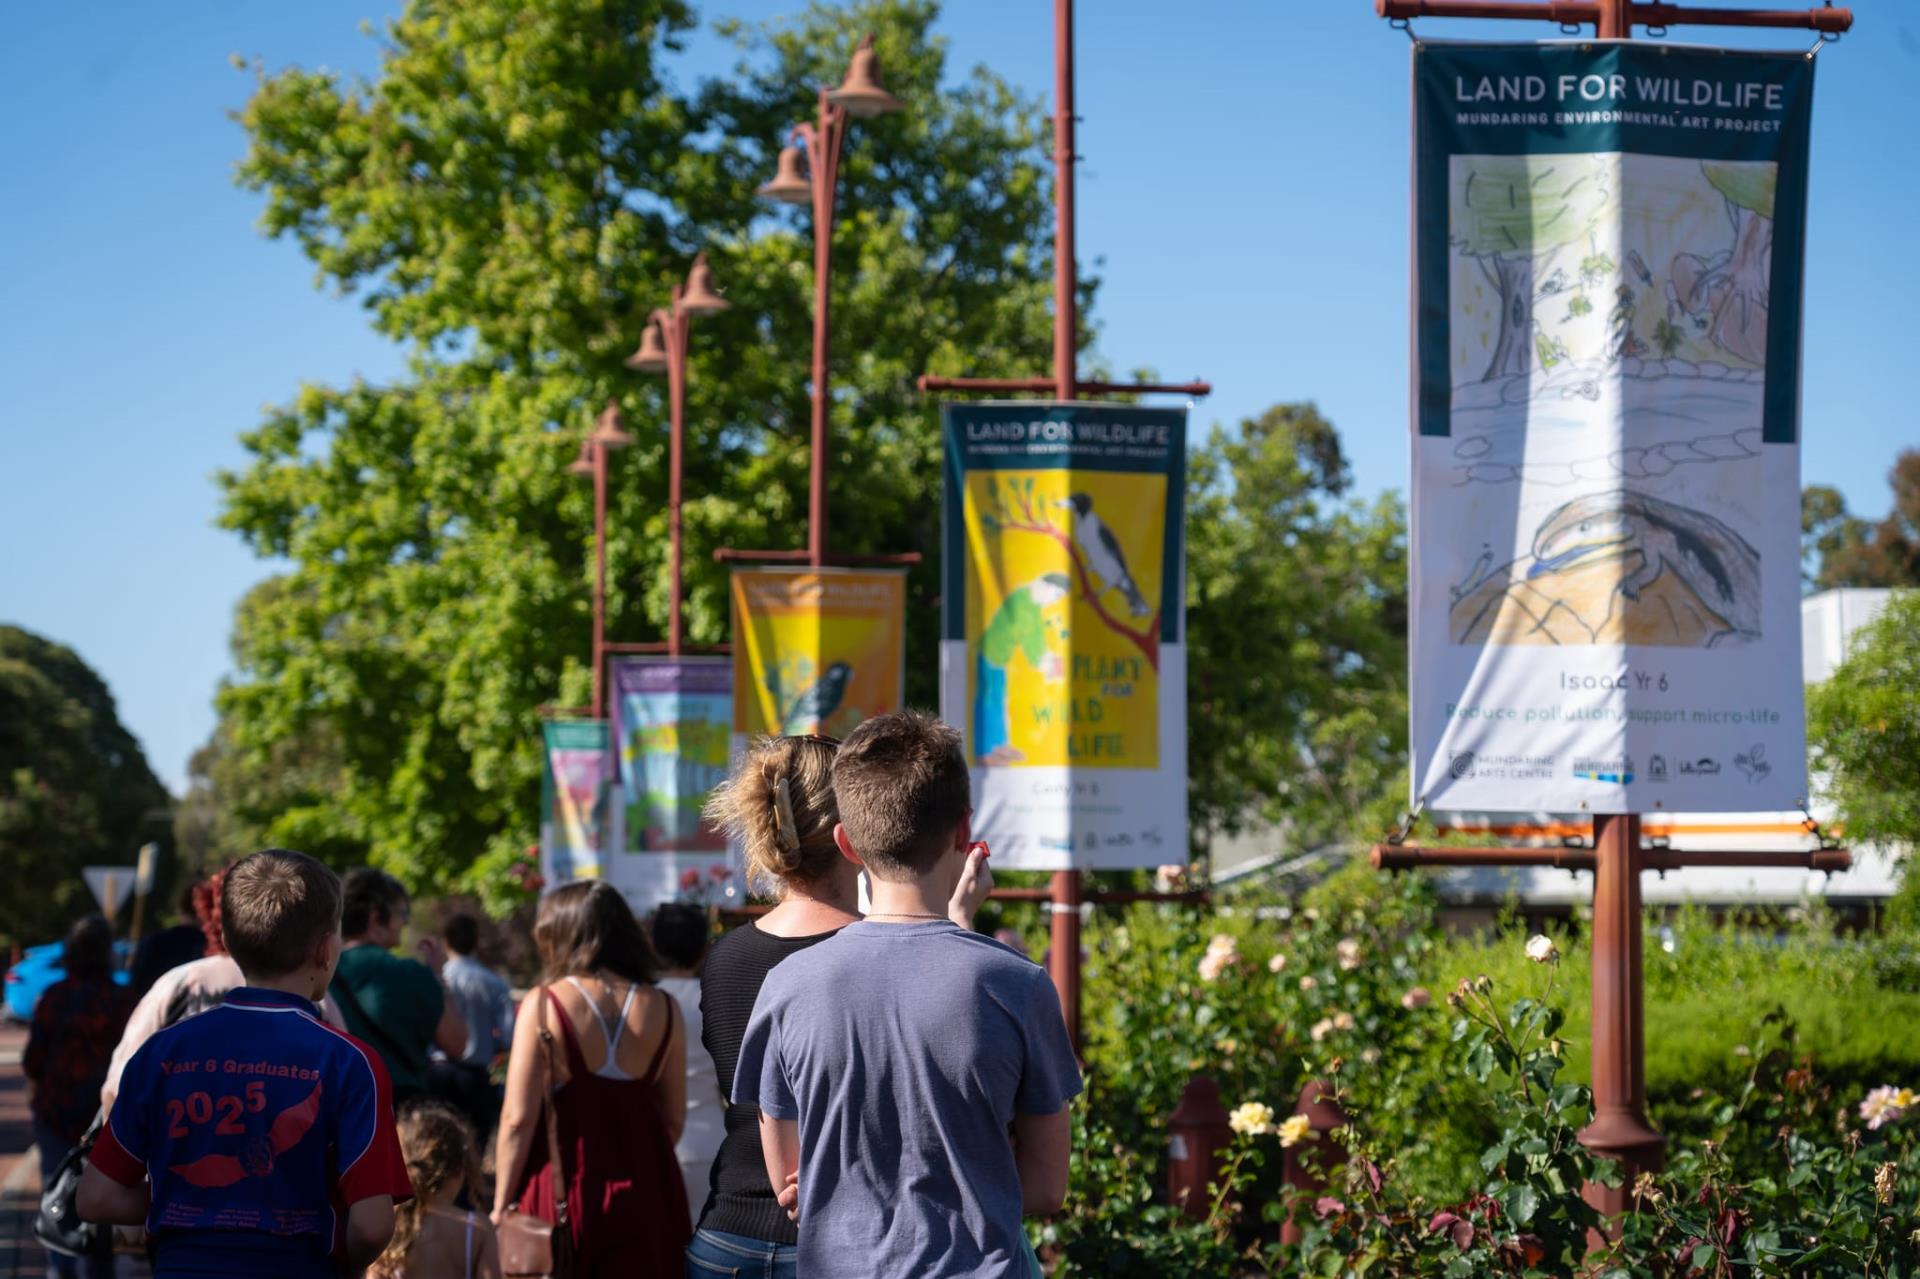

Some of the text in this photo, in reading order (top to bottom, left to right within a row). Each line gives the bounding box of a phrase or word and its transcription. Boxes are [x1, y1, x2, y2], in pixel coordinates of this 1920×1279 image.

[1456, 74, 1784, 109] LAND FOR WILDLIFE
[1456, 110, 1782, 133] MUNDARING ENVIRONMENTAL ART PROJECT
[967, 421, 1170, 445] LAND FOR WILDLIFE
[1073, 655, 1142, 682] PLANT
[1561, 671, 1669, 693] Isaac Yr 6
[1445, 704, 1518, 722] Reduce
[1629, 708, 1687, 727] support
[1692, 708, 1780, 726] micro-life
[1068, 733, 1124, 757] LIFE
[160, 1059, 320, 1081] Year 6 Graduates
[165, 1081, 267, 1138] 2025
